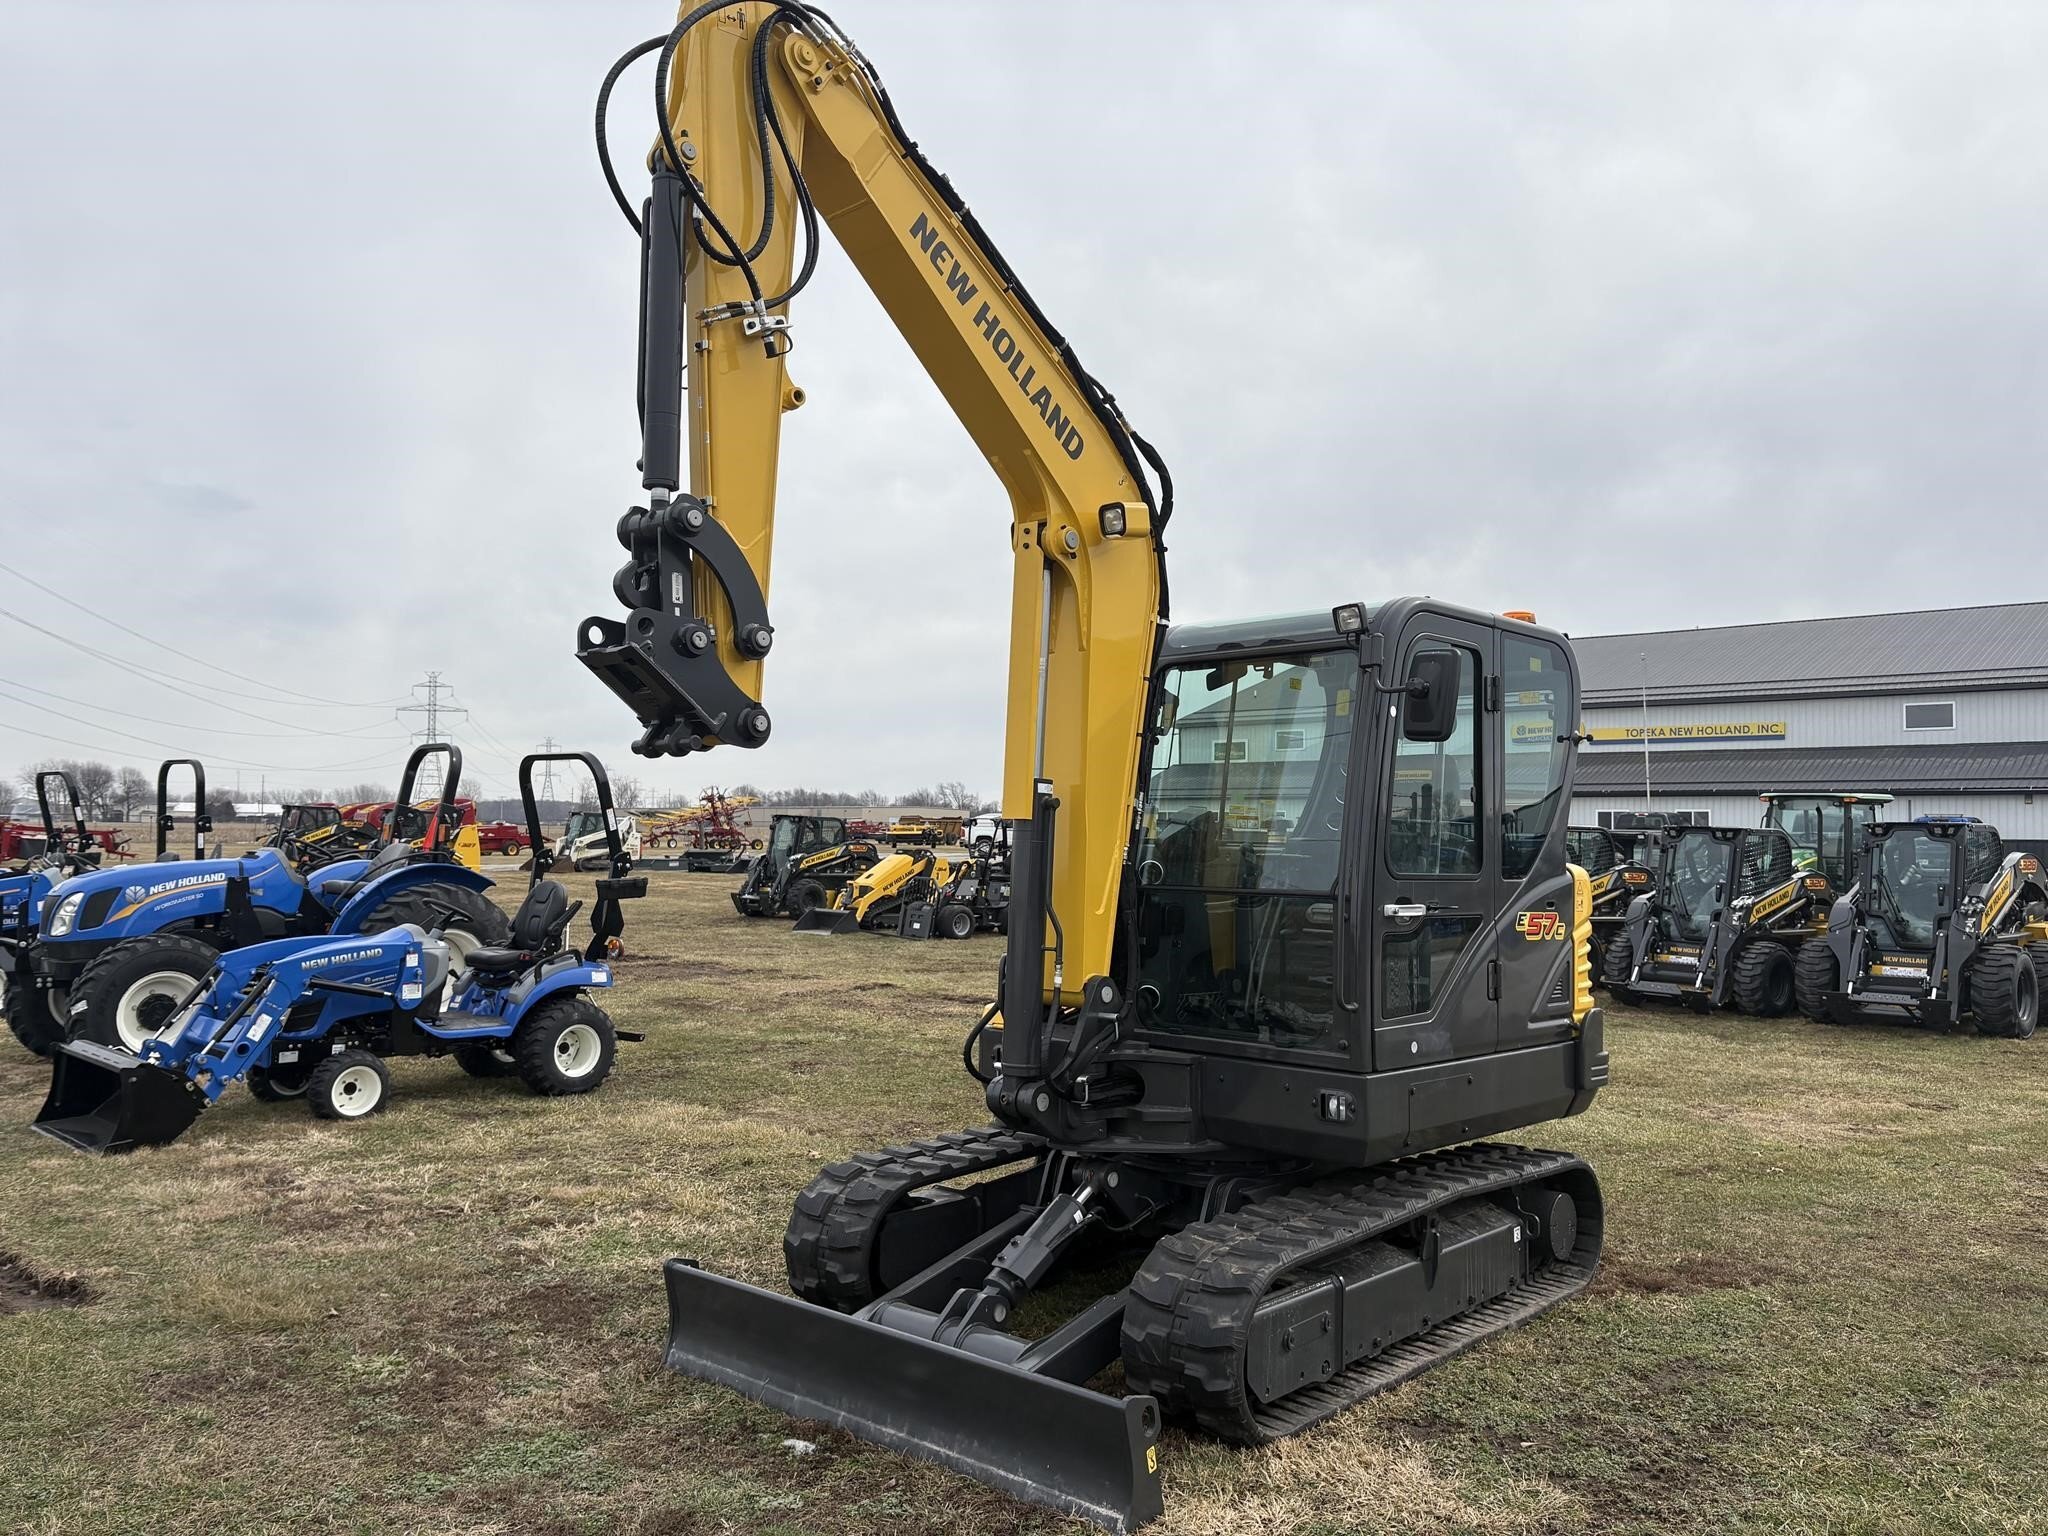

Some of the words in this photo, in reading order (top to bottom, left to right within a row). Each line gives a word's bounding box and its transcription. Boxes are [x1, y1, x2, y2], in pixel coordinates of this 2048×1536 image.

[909, 212, 979, 306] NEW
[972, 301, 1085, 461] HOLLAND
[1625, 728, 1666, 738] TOPEKA
[1669, 727, 1694, 737] NEW
[1697, 725, 1753, 736] HOLLAND,
[1757, 723, 1783, 734] INC.
[149, 880, 177, 895] NEW
[178, 872, 226, 887] HOLLAND
[882, 883, 894, 892] NEW
[894, 869, 915, 885] HOLLAND
[154, 894, 195, 912] WORKMASTER
[1755, 902, 1767, 916] NEW
[1767, 890, 1790, 908] HOLLAND
[1985, 904, 1995, 918] NEW
[1993, 880, 2009, 906] HOLLAND
[301, 958, 329, 970] NEW
[331, 948, 383, 966] HOLLAND
